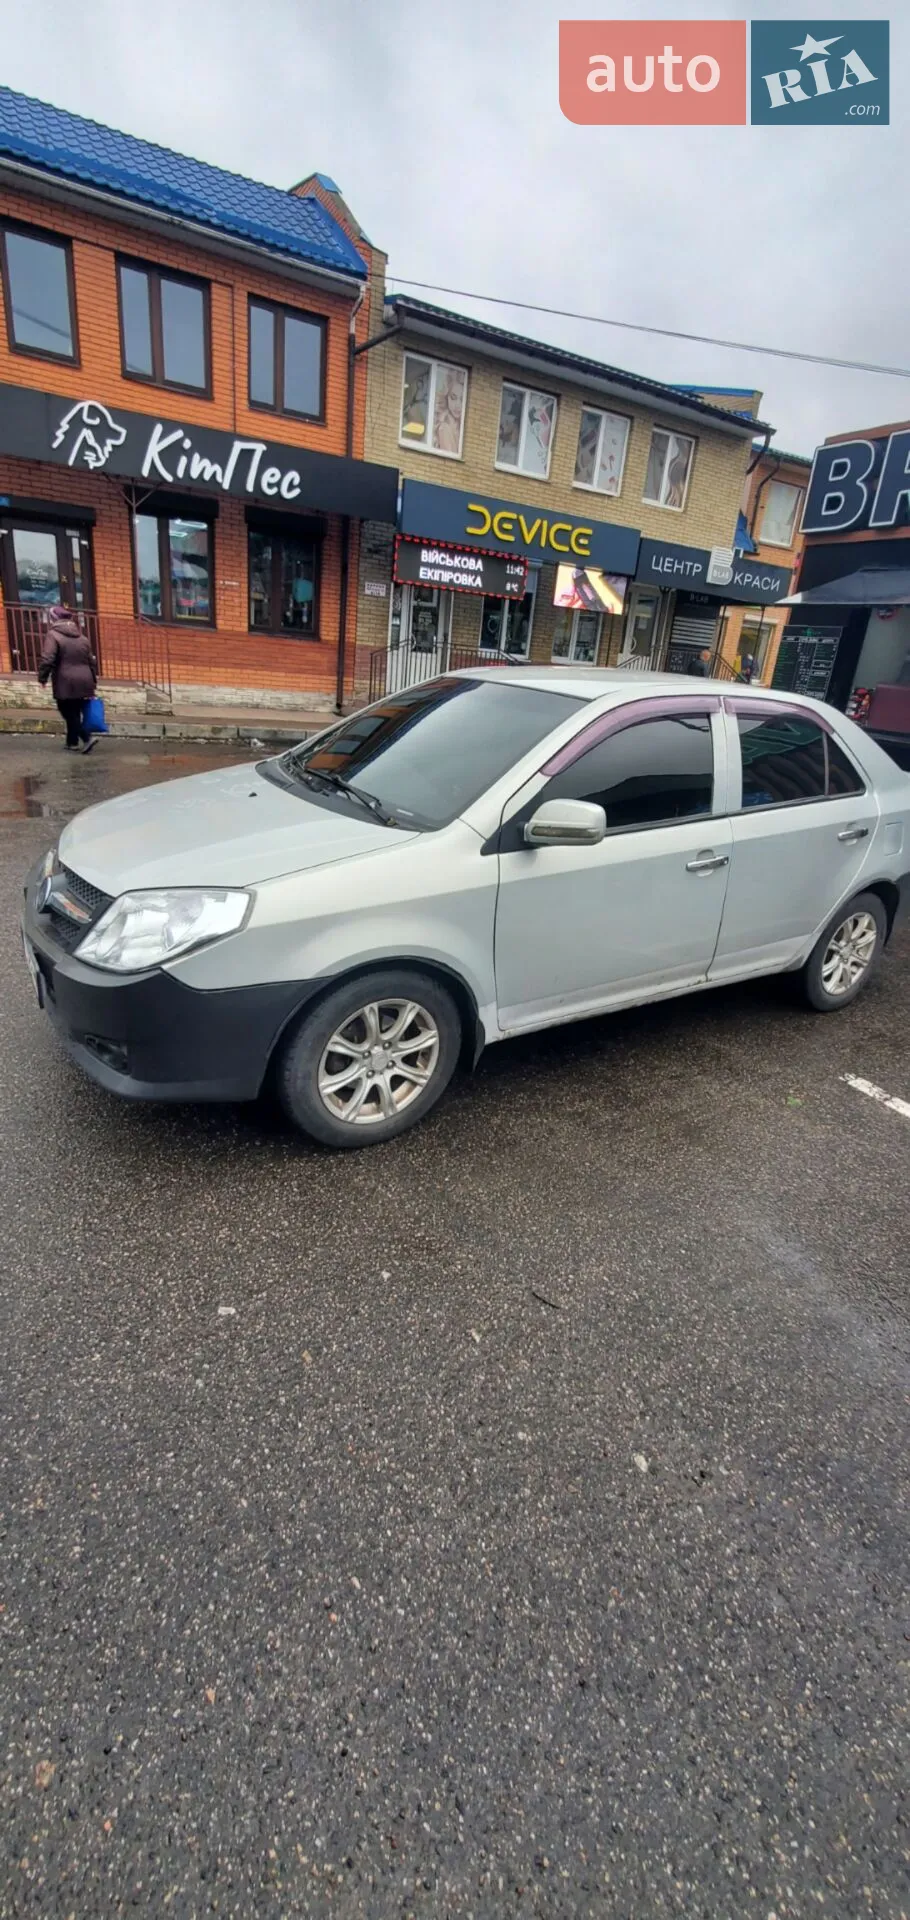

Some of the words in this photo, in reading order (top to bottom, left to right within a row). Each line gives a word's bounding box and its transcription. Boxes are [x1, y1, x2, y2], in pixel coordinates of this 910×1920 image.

[466, 504, 593, 556] DEVICE
[420, 549, 484, 572] ВІЙСЬКОВА
[651, 555, 703, 577] ЦЕНТР
[733, 571, 781, 593] КРАСИ
[419, 566, 482, 588] ЕКІПІРОВКА
